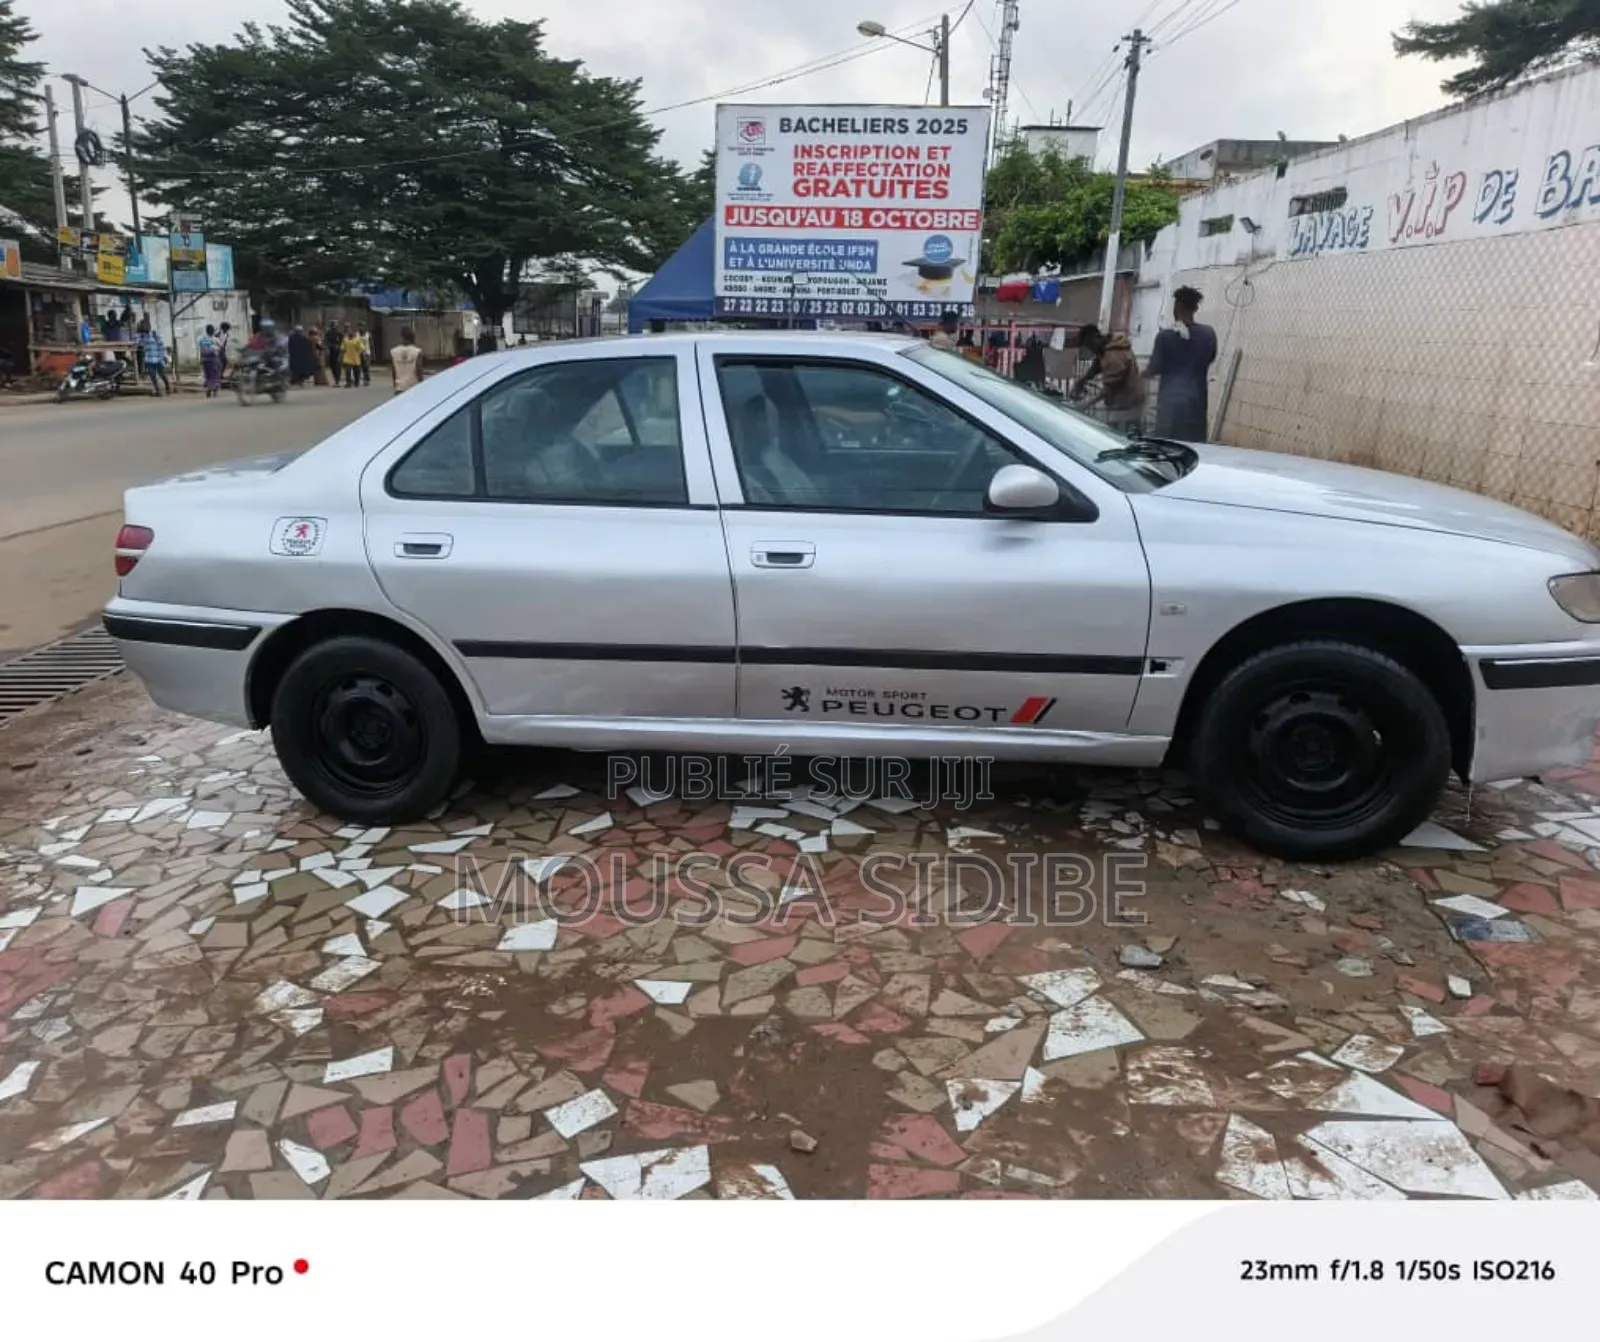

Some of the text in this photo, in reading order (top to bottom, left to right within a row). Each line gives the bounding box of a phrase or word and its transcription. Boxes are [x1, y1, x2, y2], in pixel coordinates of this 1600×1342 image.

[779, 117, 909, 134] BACHELIERS
[916, 118, 968, 135] 2025
[793, 144, 952, 160] INSCRIPTION ET
[793, 162, 951, 178] REAFFECTATION
[792, 178, 949, 199] GRATUITES
[727, 210, 978, 229] JUSQU'AU 18 OCTOBRE
[1287, 204, 1374, 256] LAVAGE
[1473, 167, 1519, 224] DE
[741, 243, 756, 253] LA
[758, 243, 806, 255] GRANDE
[809, 242, 845, 256] ÉCOLE
[729, 257, 744, 268] ET
[758, 257, 836, 270] L'UNIVERSITÉ
[724, 299, 735, 311] 27
[739, 299, 752, 311] 22
[755, 300, 768, 312] 22
[771, 300, 784, 313] 23
[825, 301, 839, 314] 22
[842, 302, 855, 315] 02
[857, 302, 870, 315] 03
[873, 303, 886, 316] 20
[928, 303, 942, 317] 33
[826, 687, 927, 701] MOTOR SPORT
[822, 699, 1007, 723] PEUGEOT
